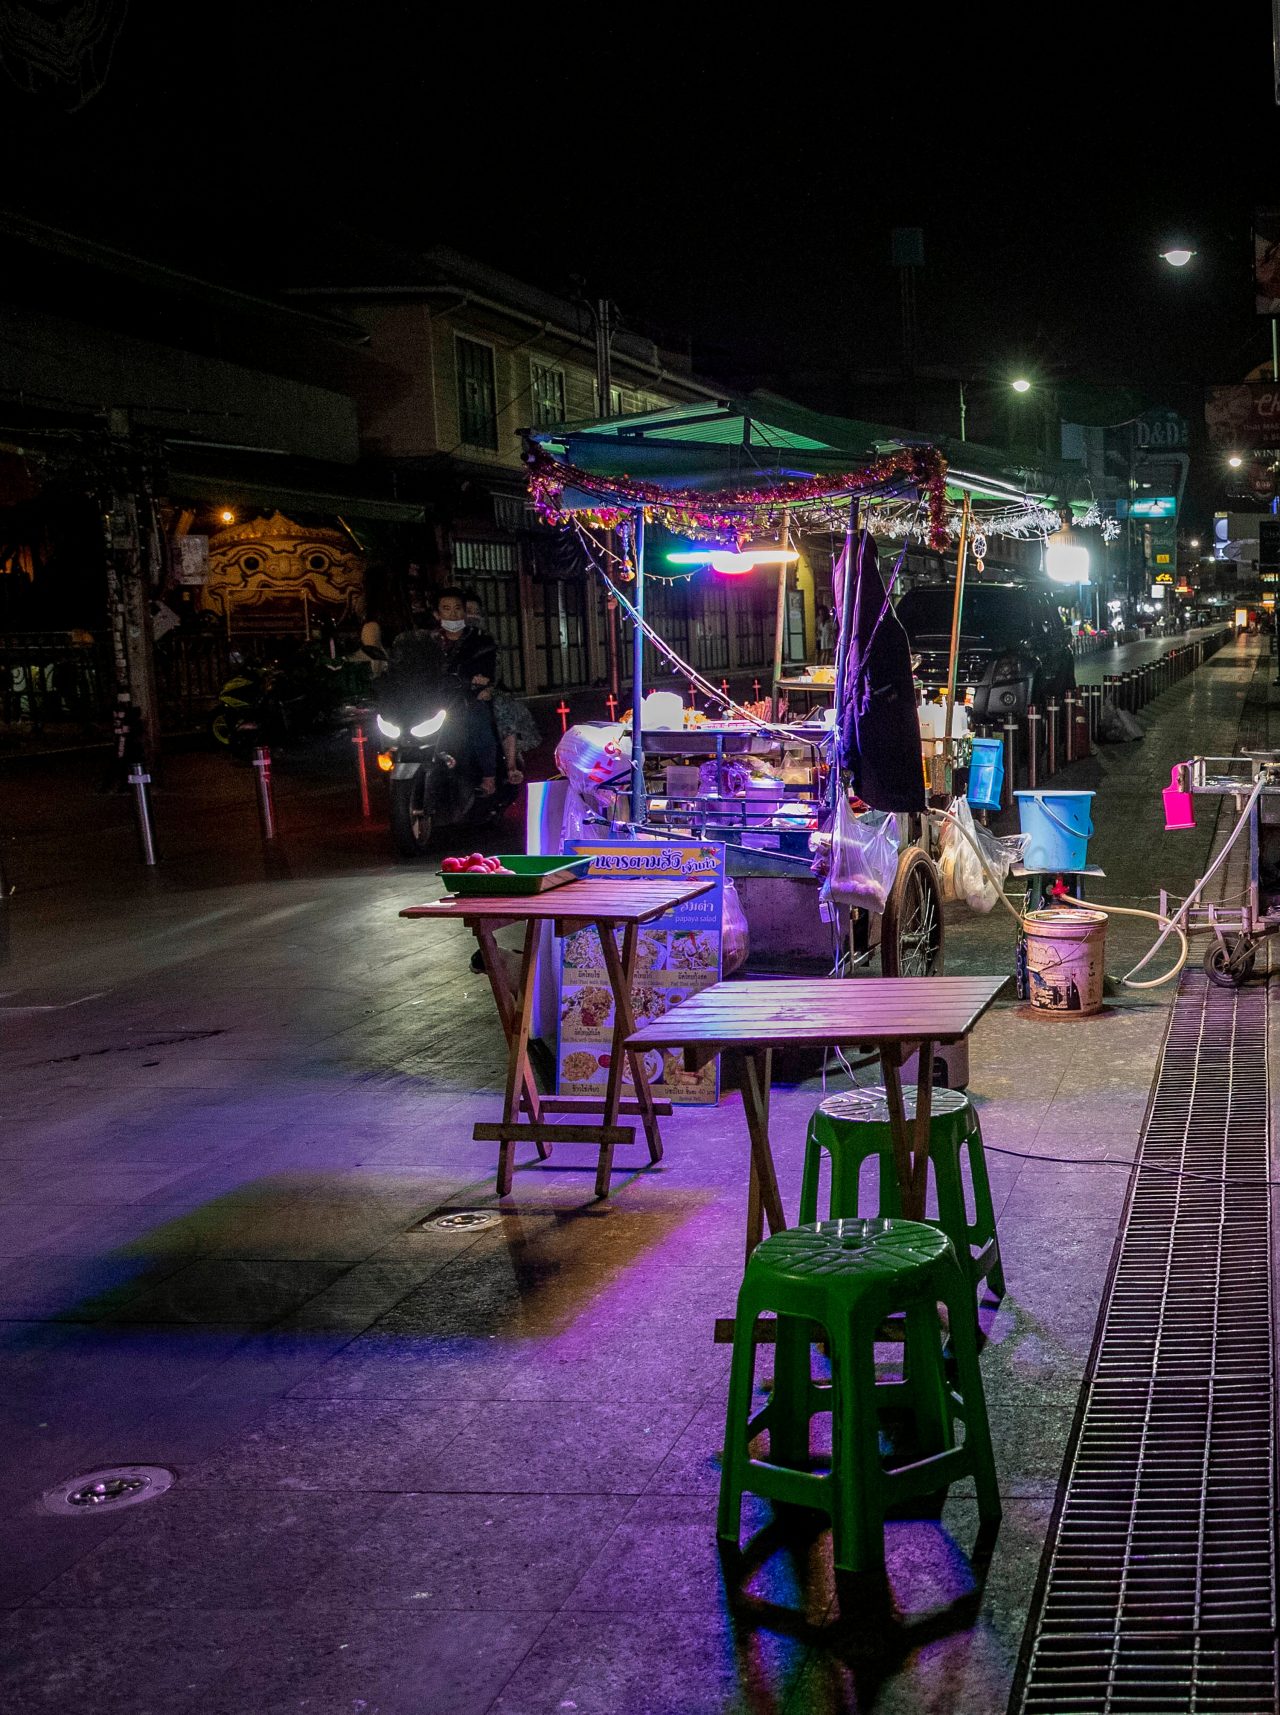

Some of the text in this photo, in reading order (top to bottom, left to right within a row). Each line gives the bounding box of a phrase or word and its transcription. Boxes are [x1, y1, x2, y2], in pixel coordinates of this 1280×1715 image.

[590, 848, 683, 871] าหารตามสั่ง
[675, 914, 717, 924] papaya salad
